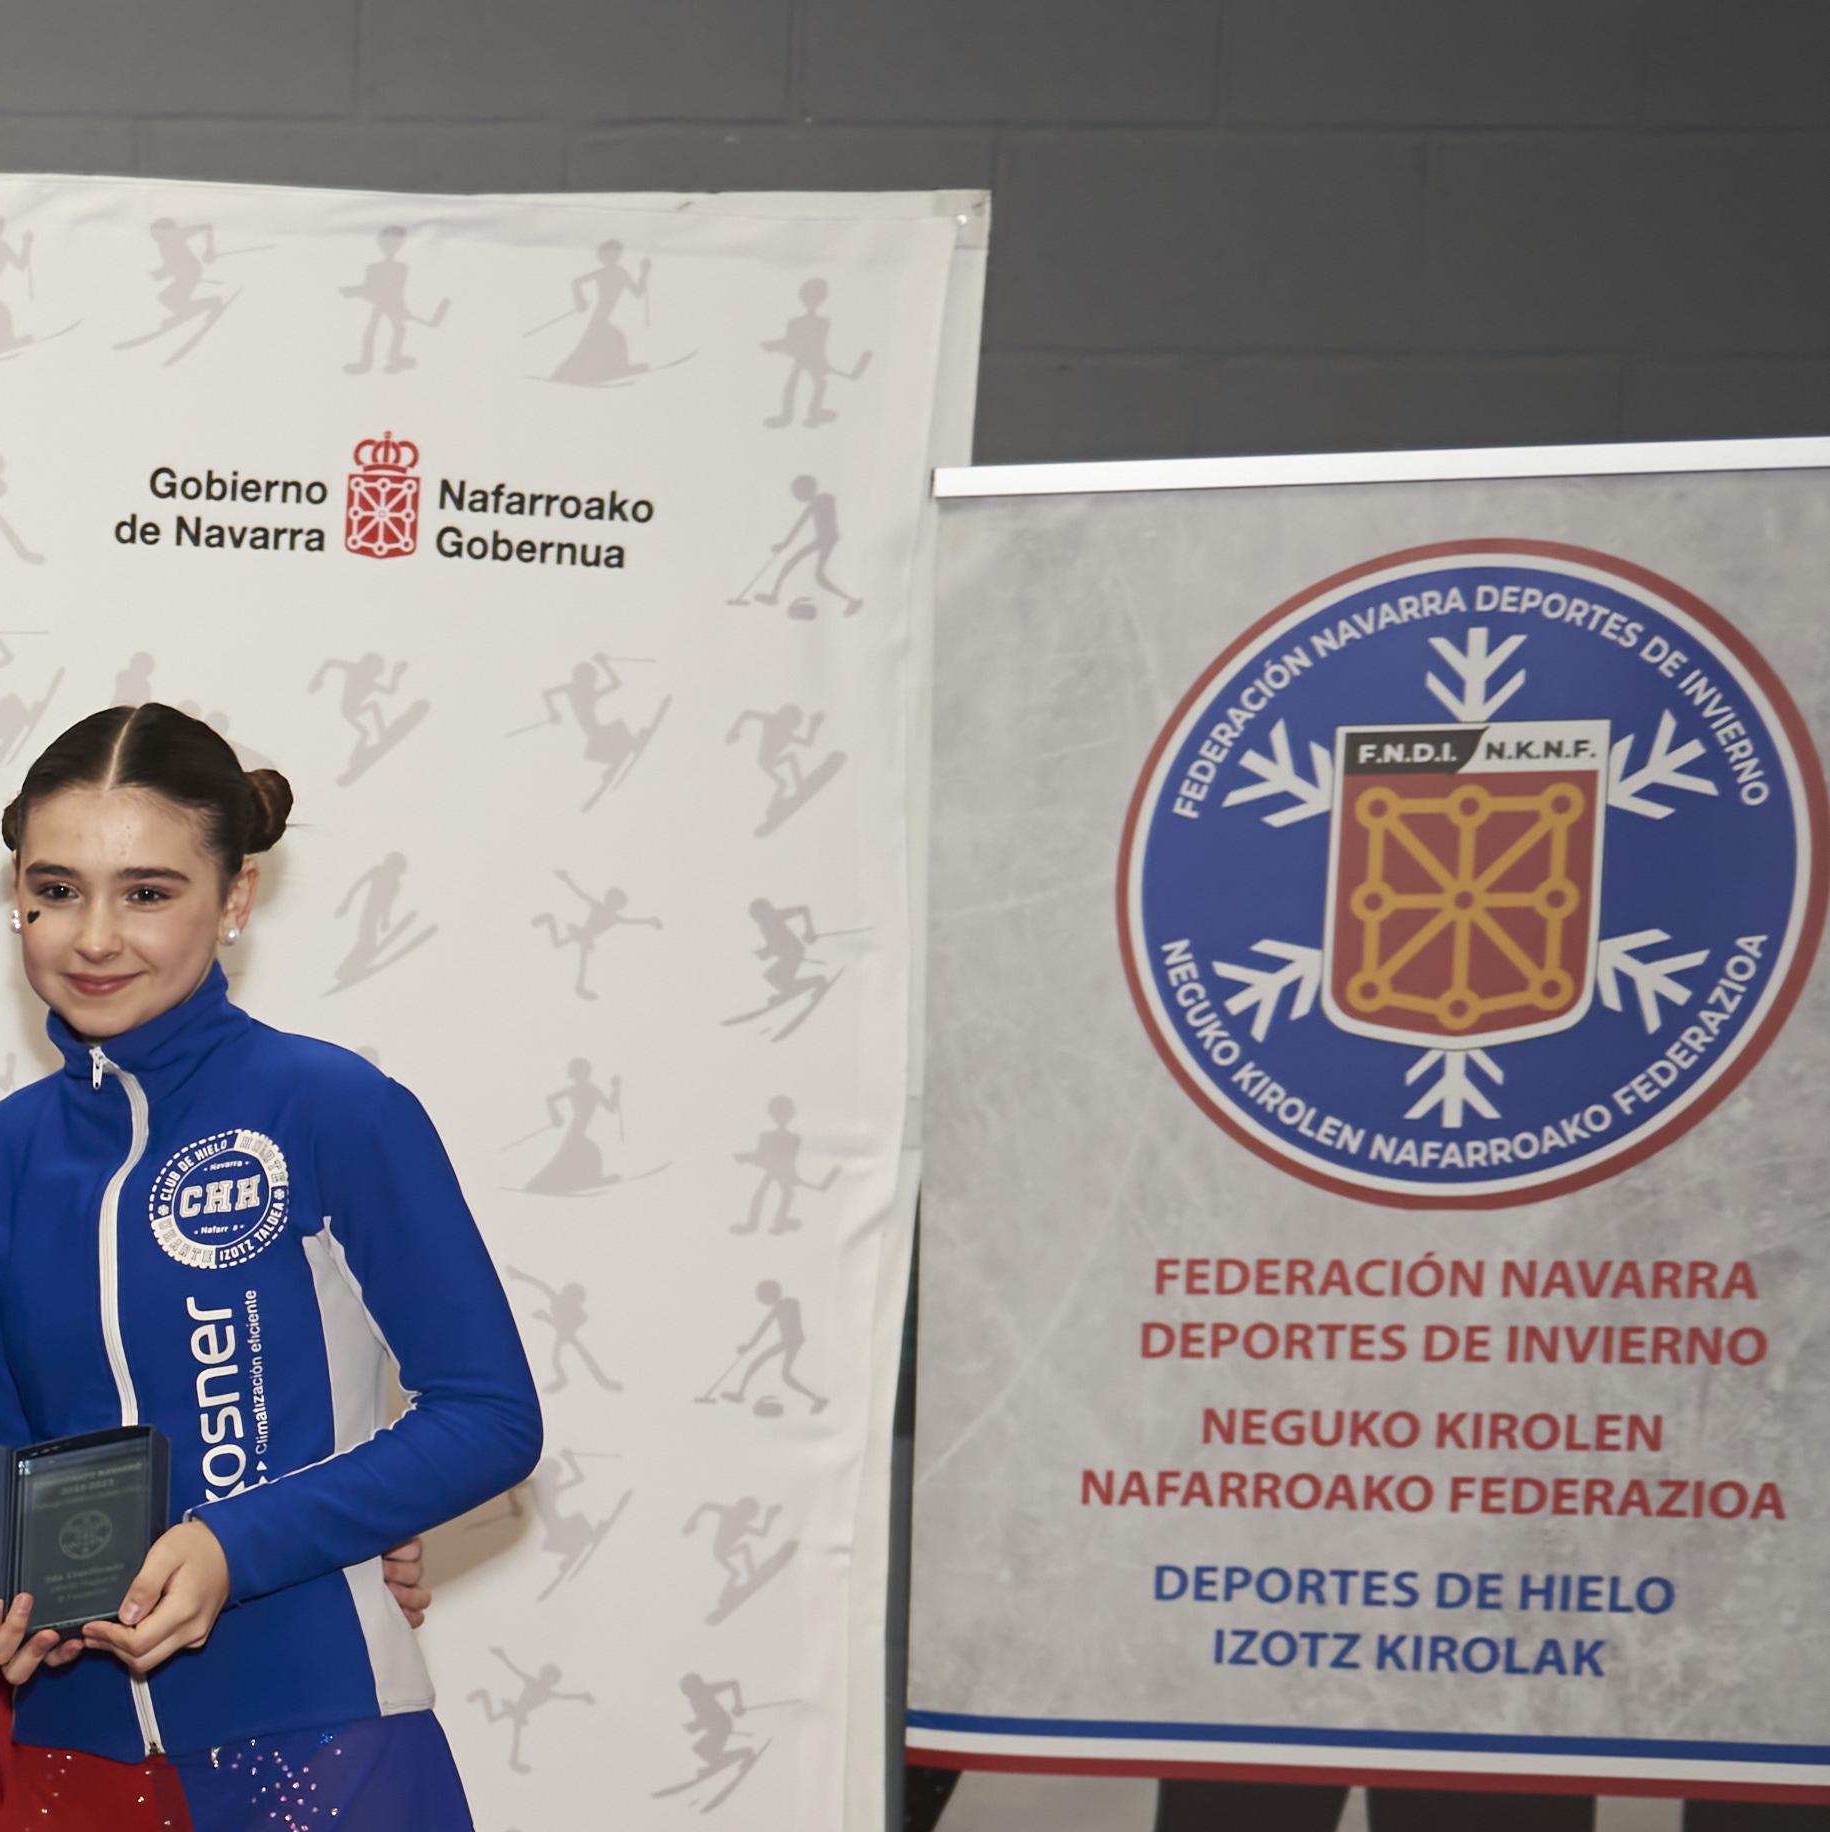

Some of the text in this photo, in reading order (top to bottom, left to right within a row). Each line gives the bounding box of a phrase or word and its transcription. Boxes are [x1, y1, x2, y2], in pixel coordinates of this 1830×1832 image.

[149, 467, 329, 505] Gobierno
[439, 479, 654, 524] Nafarroako
[115, 514, 326, 553] de Navarra
[435, 528, 626, 569] Gobernua
[1173, 585, 1770, 819] FEDERACIÓN NAVARRA DEPORTES DE INVIERNO
[1358, 739, 1597, 764] F.N.D.I. N.K.N.F.
[1160, 933, 1768, 1170] NEGUKO KIROLEN NAFARROAKO FEDERAZIOA
[160, 1139, 227, 1201] CLUB DE HIELO
[179, 1174, 261, 1218] CHH
[220, 1202, 285, 1261] IZOTZ TALDEA
[1154, 1252, 1758, 1300] FEDERACIÓN NAVARRA
[1140, 1322, 1768, 1366] DEPORTES DE INVIERNO
[245, 1289, 268, 1455] Climatización eficiente
[1201, 1408, 1664, 1452] NEGUKO KIROLEN
[1080, 1469, 1787, 1520] NAFARROAKO FEDERAZIOA
[1153, 1564, 1676, 1615] DEPORTES DE HIELO
[1212, 1628, 1606, 1676] IZOTZ KIROLAK
